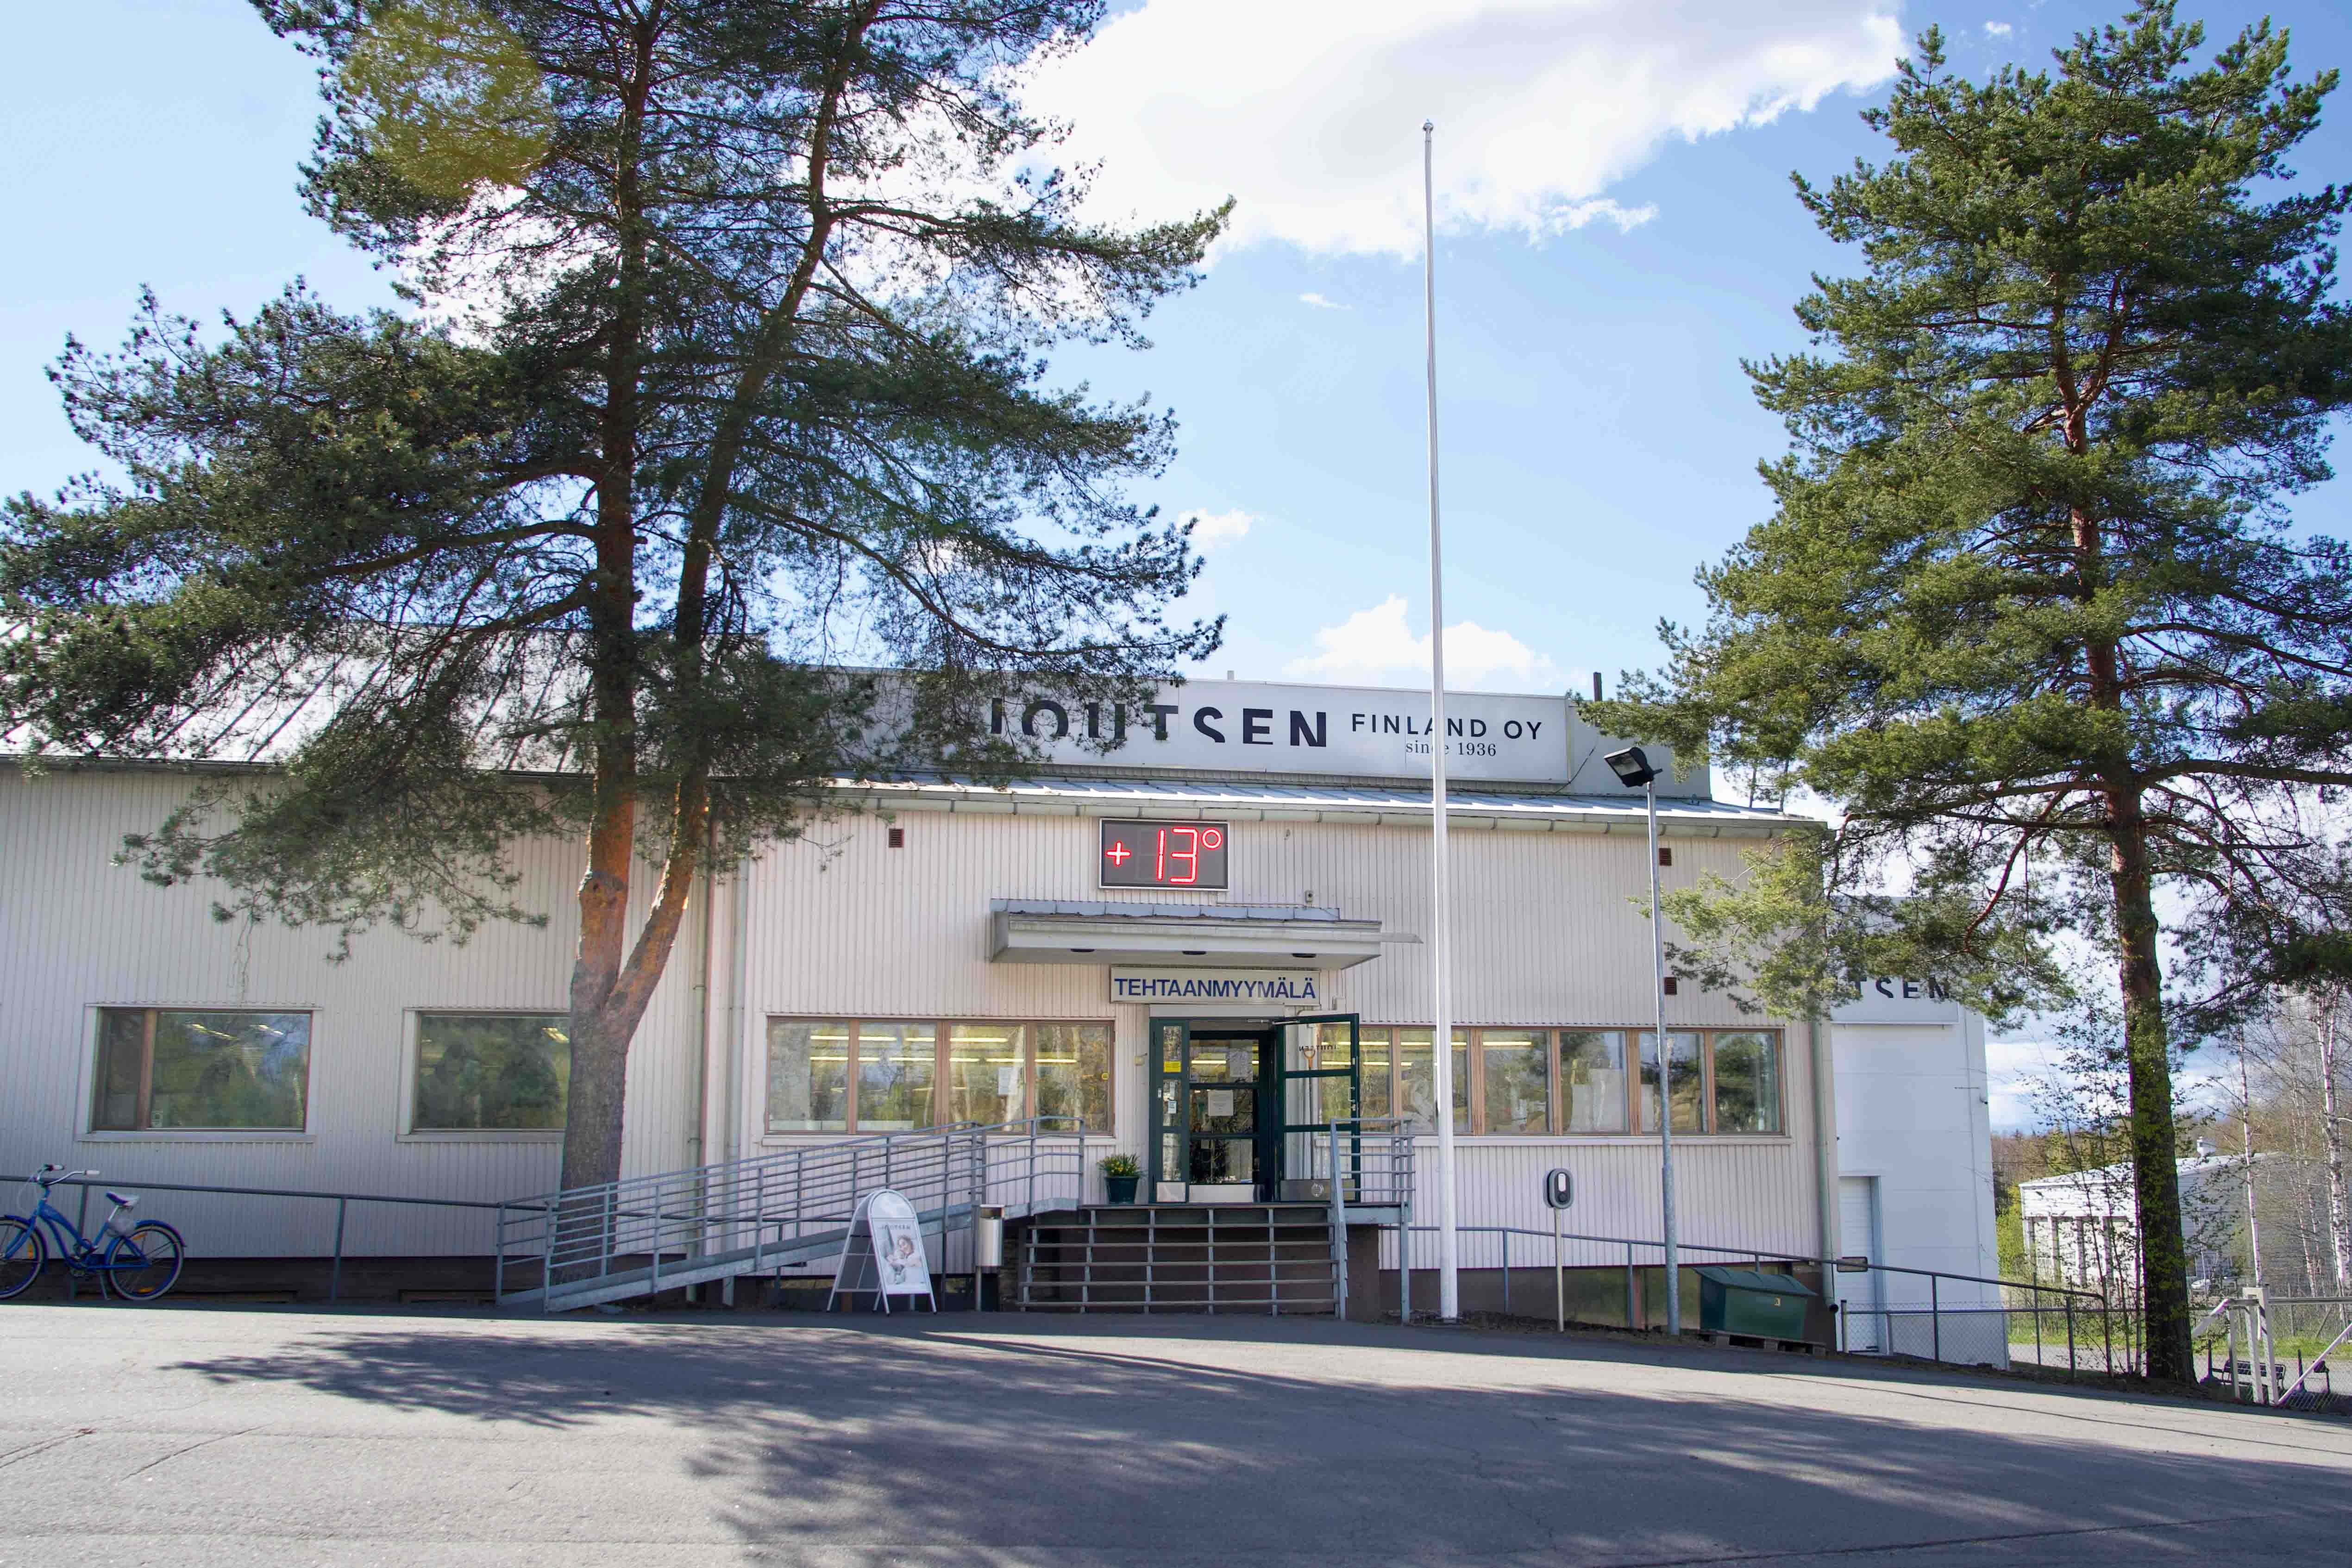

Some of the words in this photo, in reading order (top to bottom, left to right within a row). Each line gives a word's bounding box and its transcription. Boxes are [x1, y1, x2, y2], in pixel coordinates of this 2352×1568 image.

[1504, 720, 1543, 740] OY
[1458, 742, 1497, 756] 1936
[1114, 977, 1316, 999] TEHTAANMYYMÄLÄ
